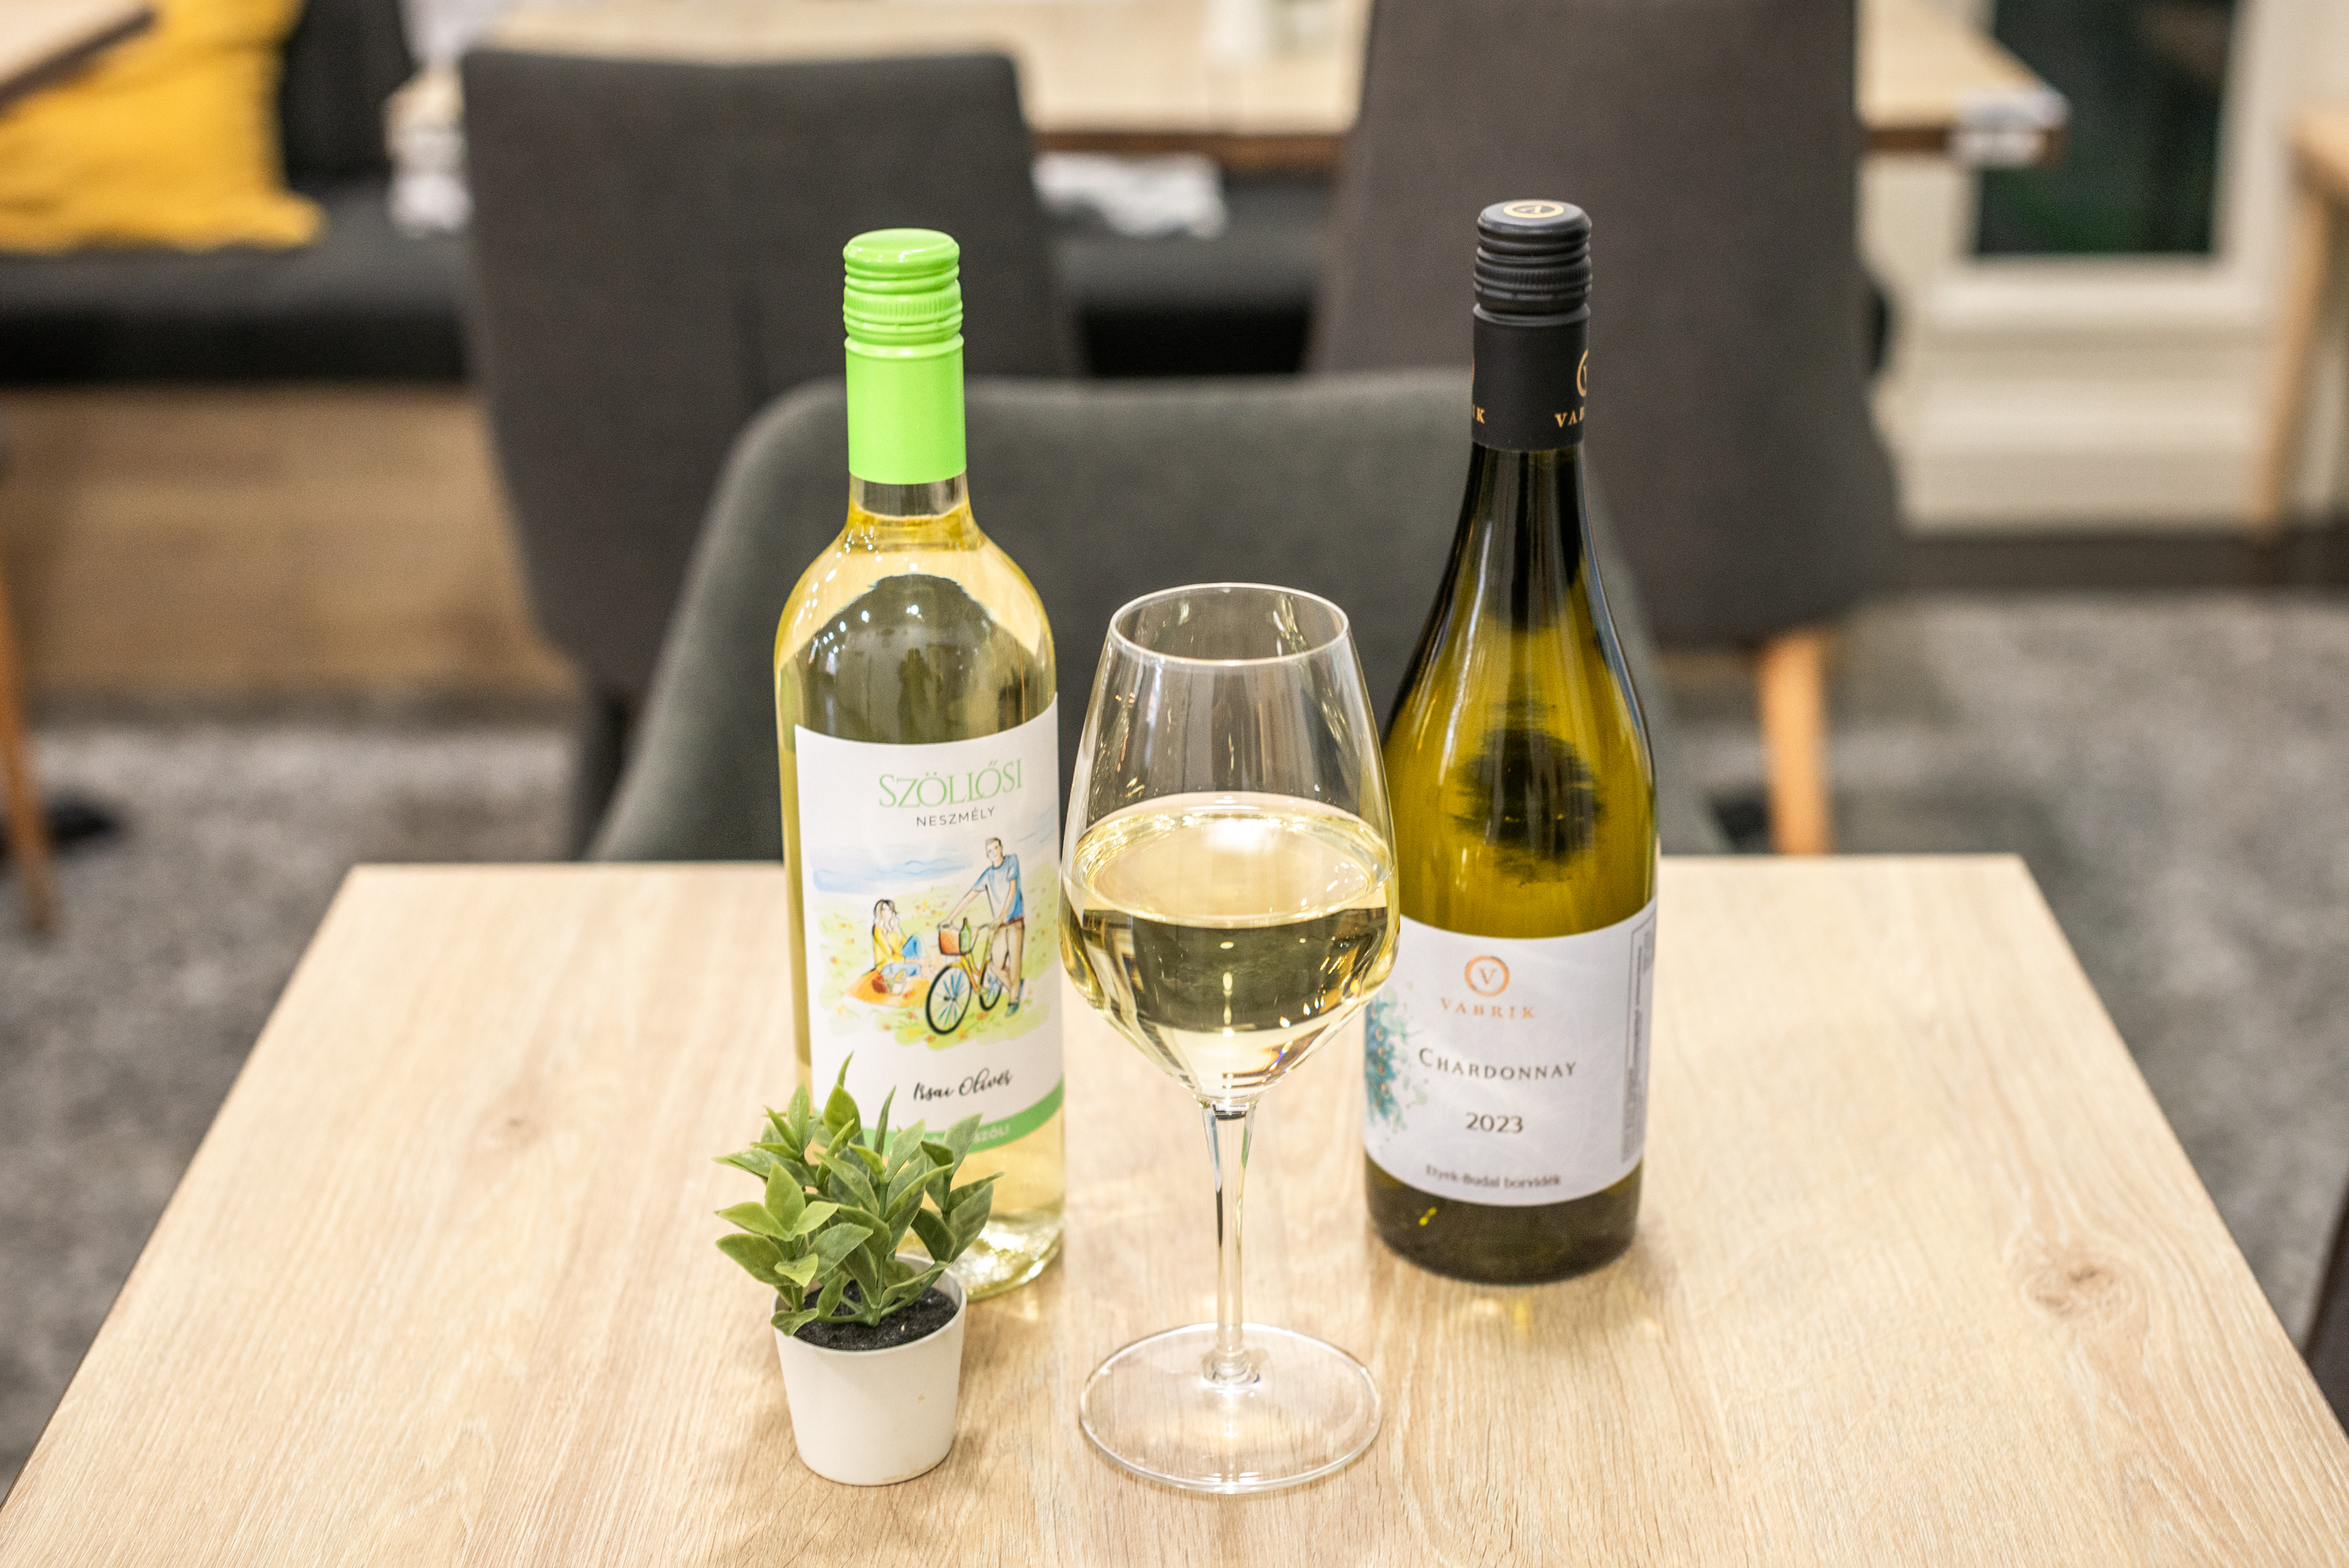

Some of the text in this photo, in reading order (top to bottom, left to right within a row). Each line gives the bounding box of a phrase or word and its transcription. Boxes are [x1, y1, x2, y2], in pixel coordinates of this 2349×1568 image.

[915, 806, 995, 827] NESZMÉLY
[1440, 997, 1535, 1019] VABRIK
[1419, 1047, 1577, 1081] CHARDONNAY
[1465, 1112, 1525, 1134] 2023
